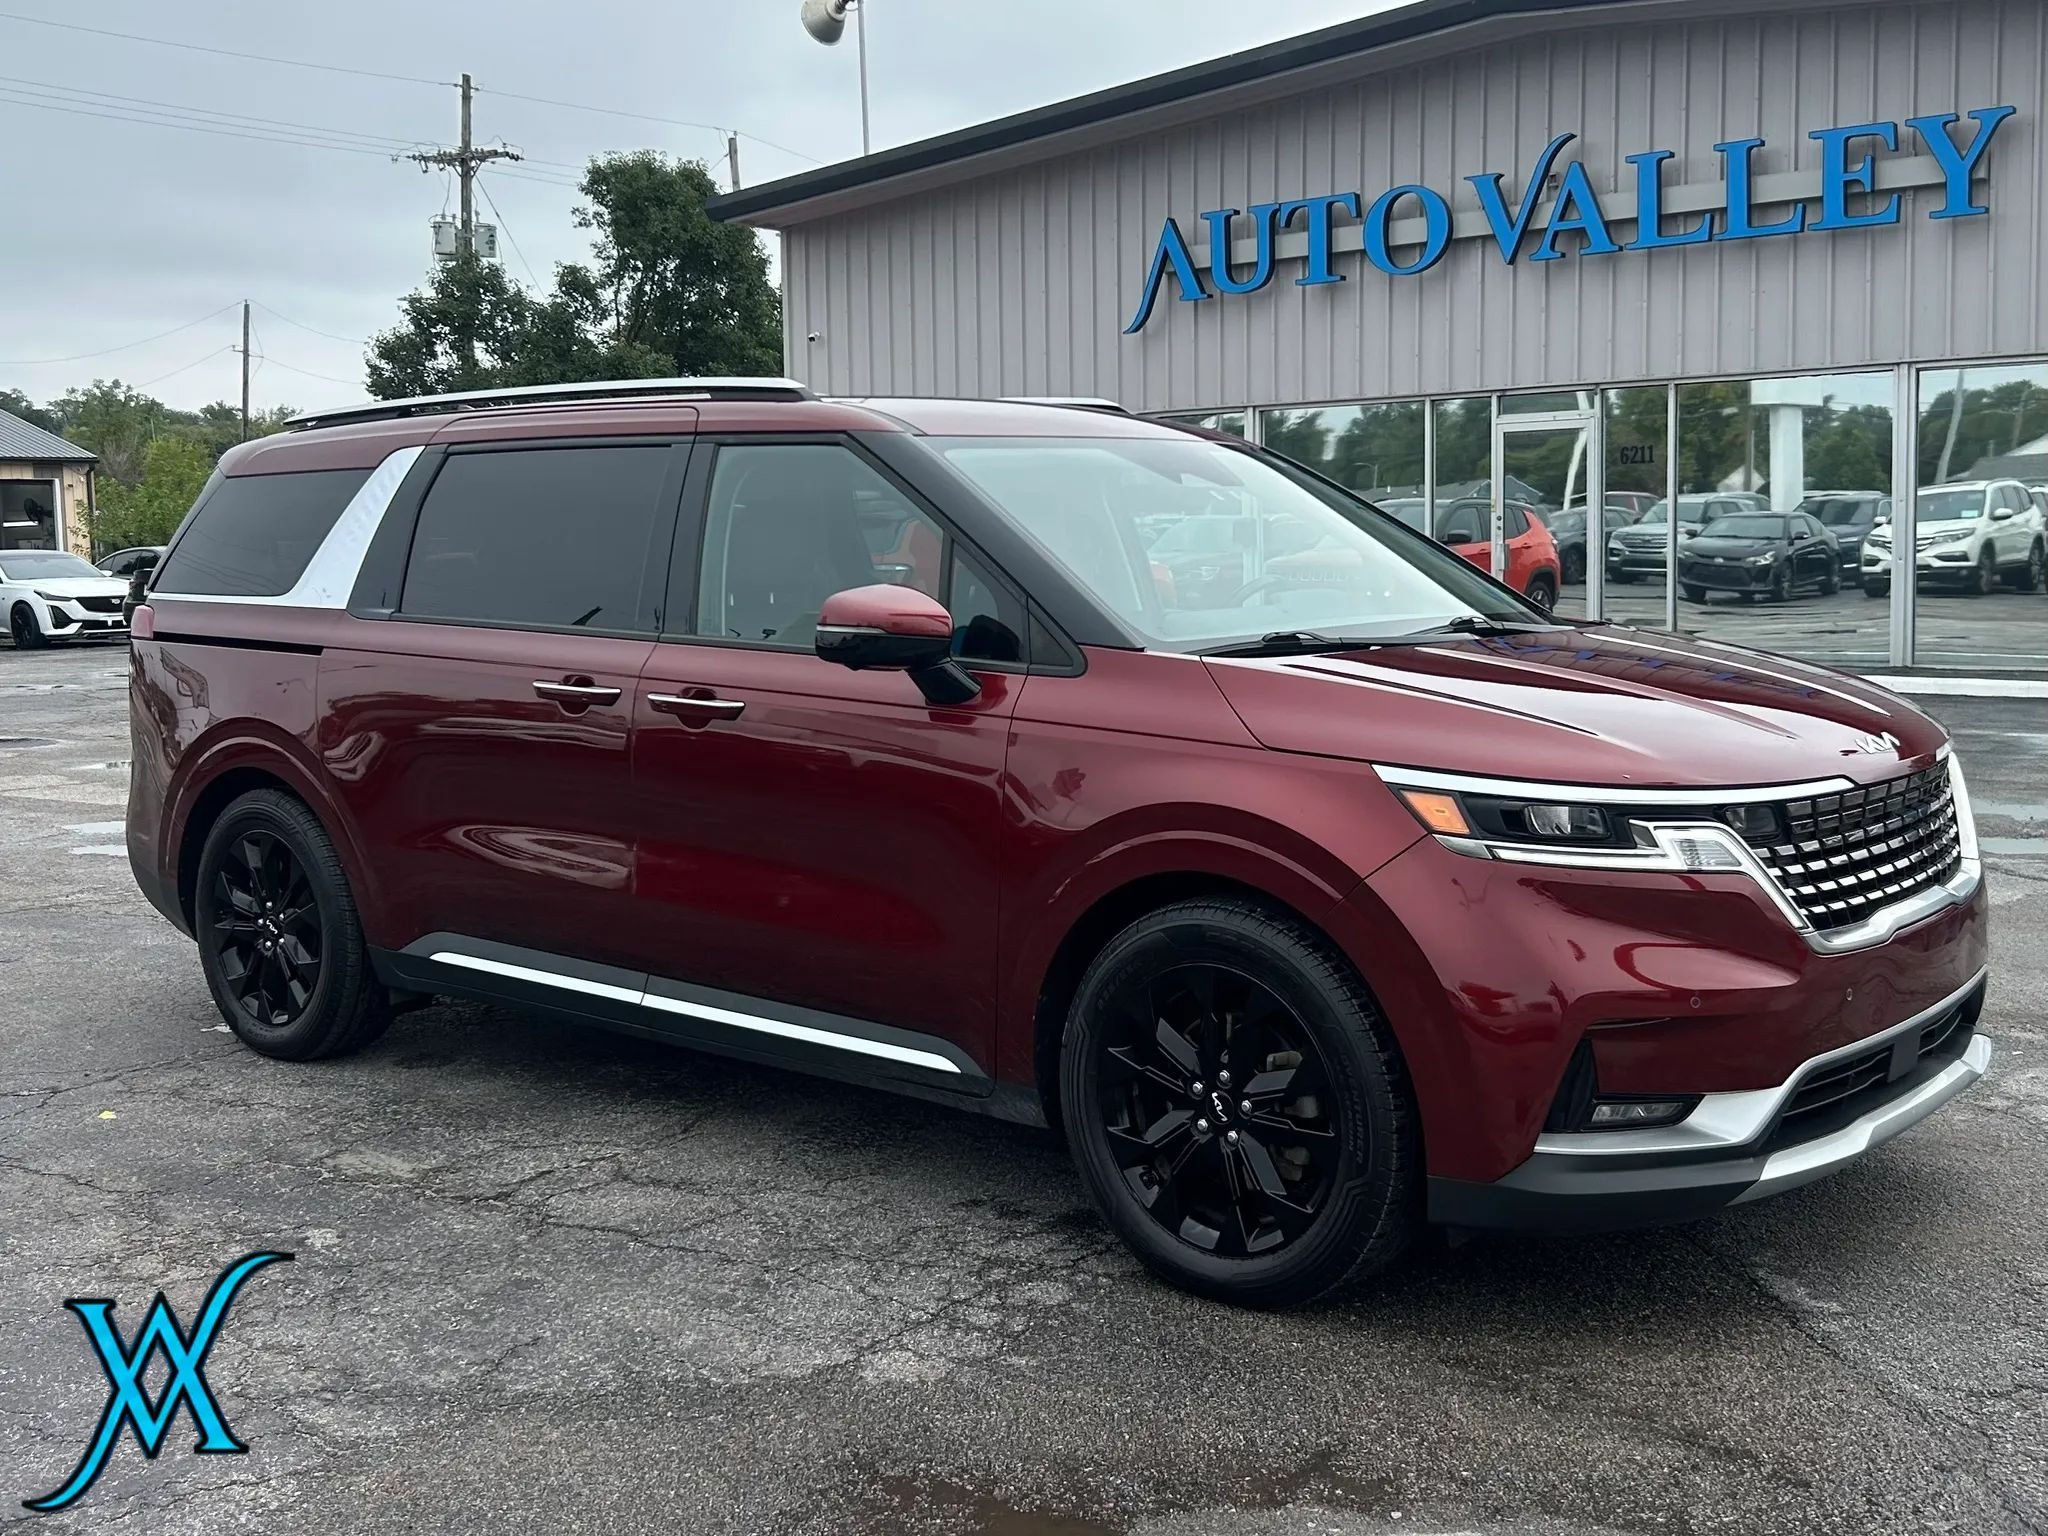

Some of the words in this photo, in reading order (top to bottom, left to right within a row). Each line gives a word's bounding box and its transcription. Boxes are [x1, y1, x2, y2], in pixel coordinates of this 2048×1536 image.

[1123, 184, 1452, 334] AUTO
[1464, 106, 2016, 266] VALLEY
[1620, 444, 1655, 464] 6211
